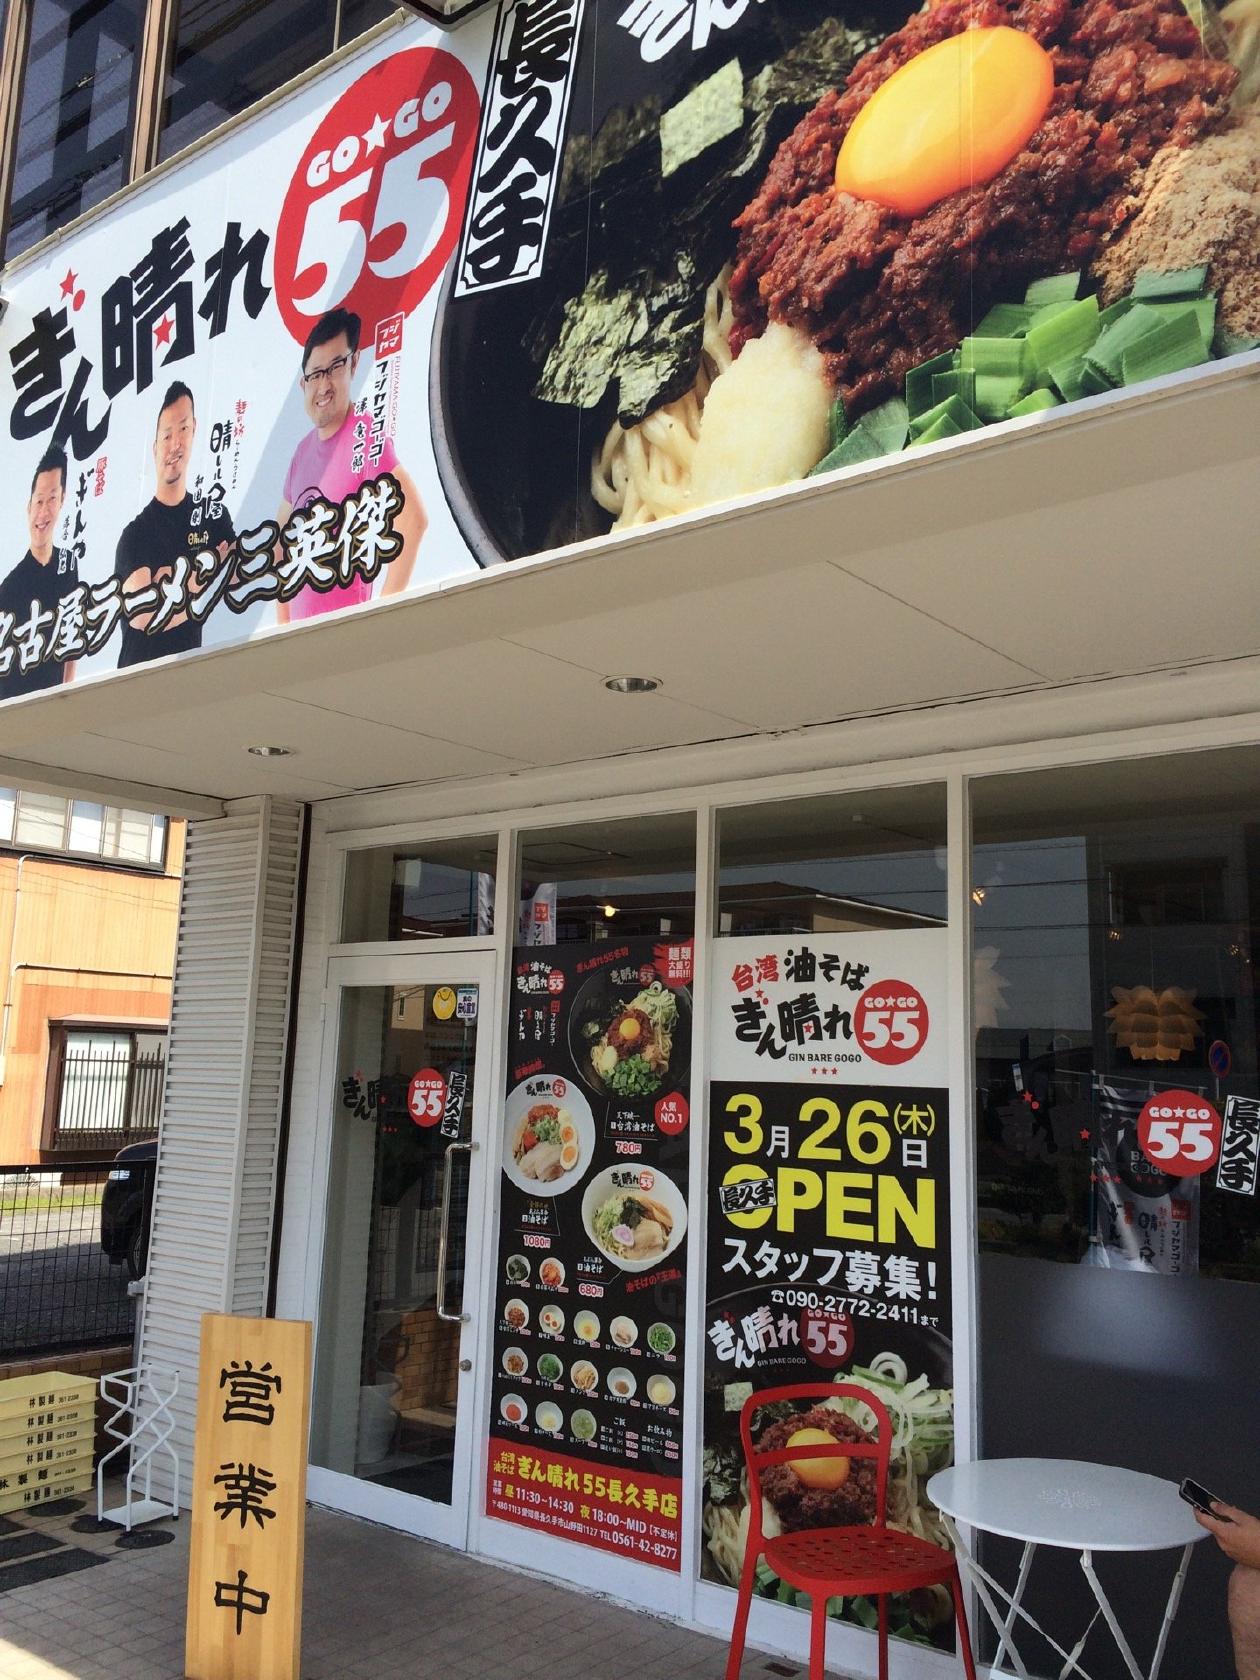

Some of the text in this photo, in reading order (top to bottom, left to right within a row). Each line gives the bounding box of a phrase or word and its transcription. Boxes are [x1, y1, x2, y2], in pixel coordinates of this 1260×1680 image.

[292, 122, 456, 315] 55
[8, 216, 272, 462] ぎん晴れ
[548, 978, 564, 991] 55
[640, 971, 654, 982] 55
[731, 988, 853, 1060] ぎん晴れ
[862, 1010, 921, 1049] 55
[788, 1053, 862, 1064] GIN BARE GOGO
[411, 1089, 443, 1116] 55
[443, 1072, 466, 1136] 長久手
[661, 1101, 677, 1112] 人気
[616, 1142, 642, 1154] 780円
[1146, 1122, 1214, 1161] 55
[1219, 1098, 1259, 1194] 長久手
[721, 1180, 775, 1212] 長久手
[722, 1163, 936, 1249] OPEN
[523, 1235, 551, 1248] 1080円
[722, 1237, 937, 1301] スタッフ募集!
[578, 1283, 604, 1297] 680円
[708, 1304, 800, 1369] ぎん晴れ
[806, 1320, 848, 1356] 55
[493, 1461, 515, 1476] 油そば
[500, 1451, 516, 1465] 台湾
[213, 1360, 282, 1636] 営業中
[579, 1504, 591, 1520] 夜
[599, 1529, 612, 1541] TEL
[612, 1530, 678, 1561] 0561-42-8277
